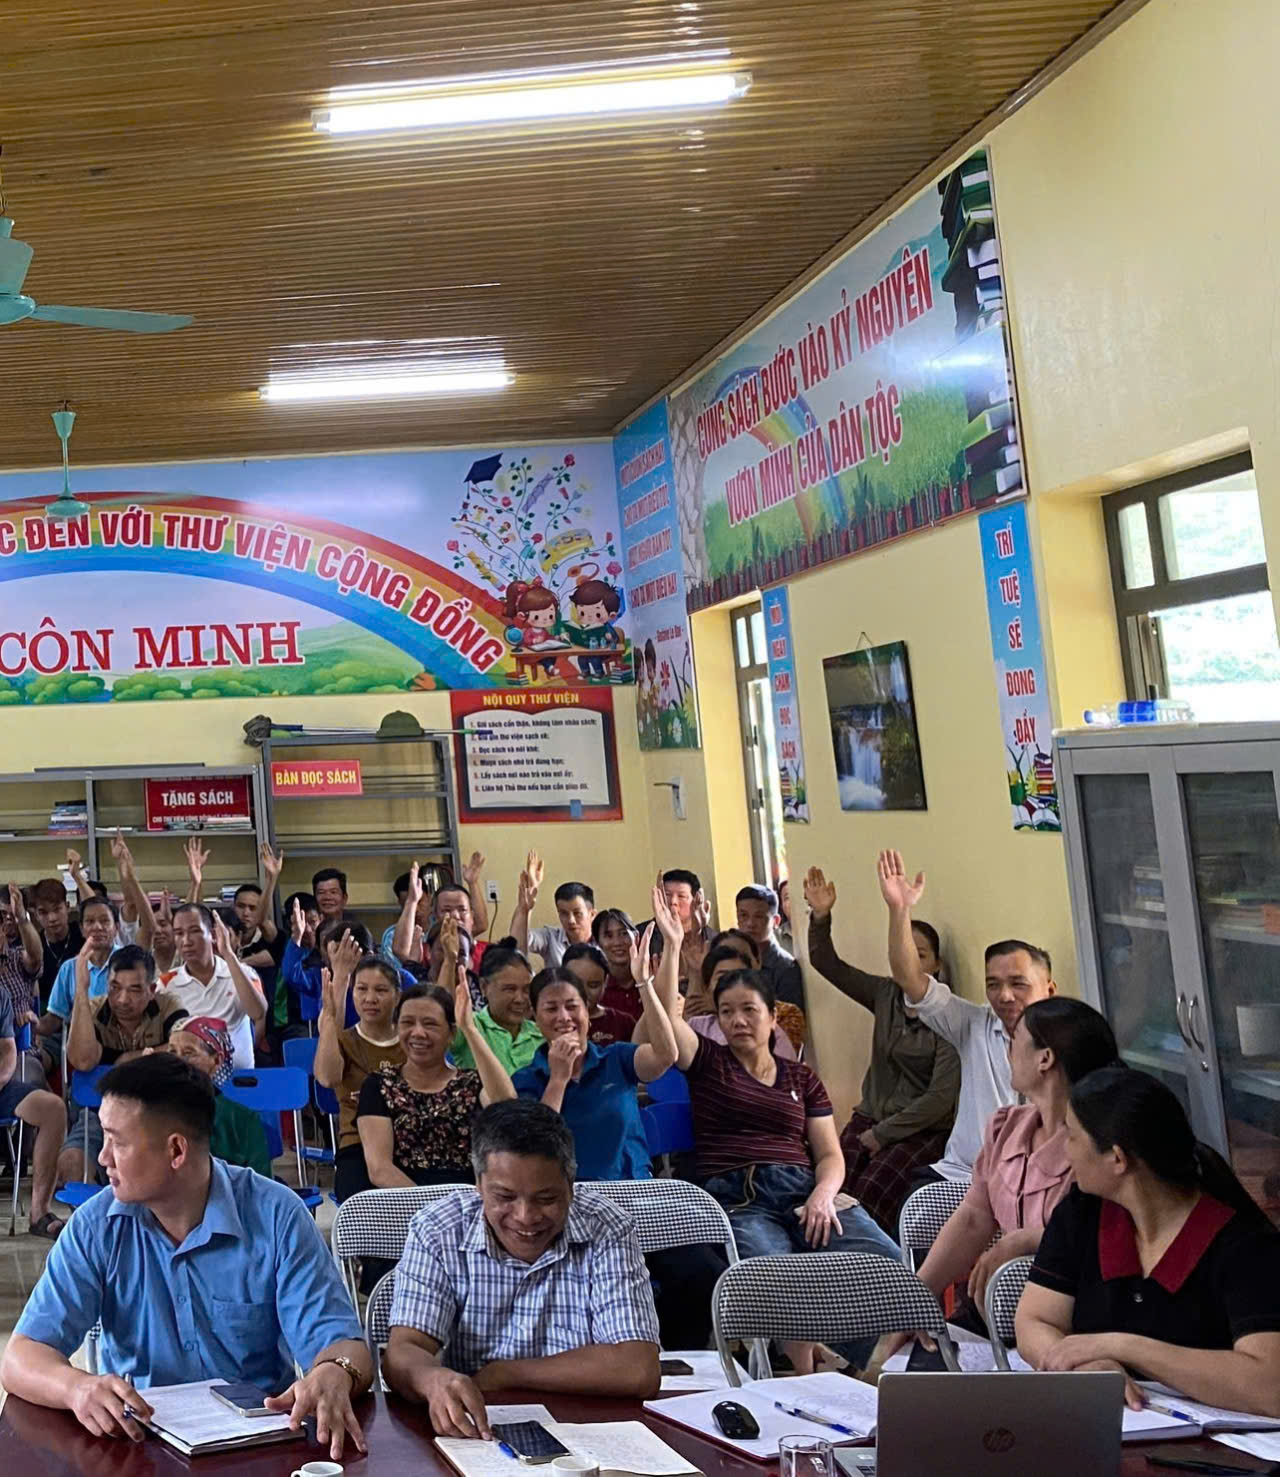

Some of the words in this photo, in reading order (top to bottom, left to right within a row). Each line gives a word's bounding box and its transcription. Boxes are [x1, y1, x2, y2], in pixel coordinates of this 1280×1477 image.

[697, 400, 727, 460] CÙNG
[727, 376, 761, 439] SÁCH
[761, 345, 797, 416] BƯỚC
[799, 322, 829, 390] VÀO
[831, 289, 852, 370] KỶ
[856, 248, 933, 353] NGUYÊN
[726, 466, 758, 525] VƯƠN
[759, 444, 795, 509] MÌNH
[797, 414, 829, 489] CỦA
[828, 402, 865, 474] DÂN
[865, 380, 902, 463] TỘC
[996, 523, 1013, 557] TRÍ
[101, 506, 152, 546] VỚI
[163, 515, 229, 551] THƯ
[235, 525, 312, 570] VIỆN
[318, 546, 411, 609] CỘNG
[409, 588, 504, 672] ĐỒNG
[133, 621, 304, 669] MINH
[483, 693, 502, 707] NỘI
[505, 694, 527, 706] QUY
[530, 692, 552, 704] THƯ
[553, 691, 579, 706] VIỆN
[301, 770, 324, 788] ĐỌC
[327, 767, 357, 785] SÁCH
[161, 789, 196, 809] TẶNG
[199, 788, 234, 806] SÁCH
